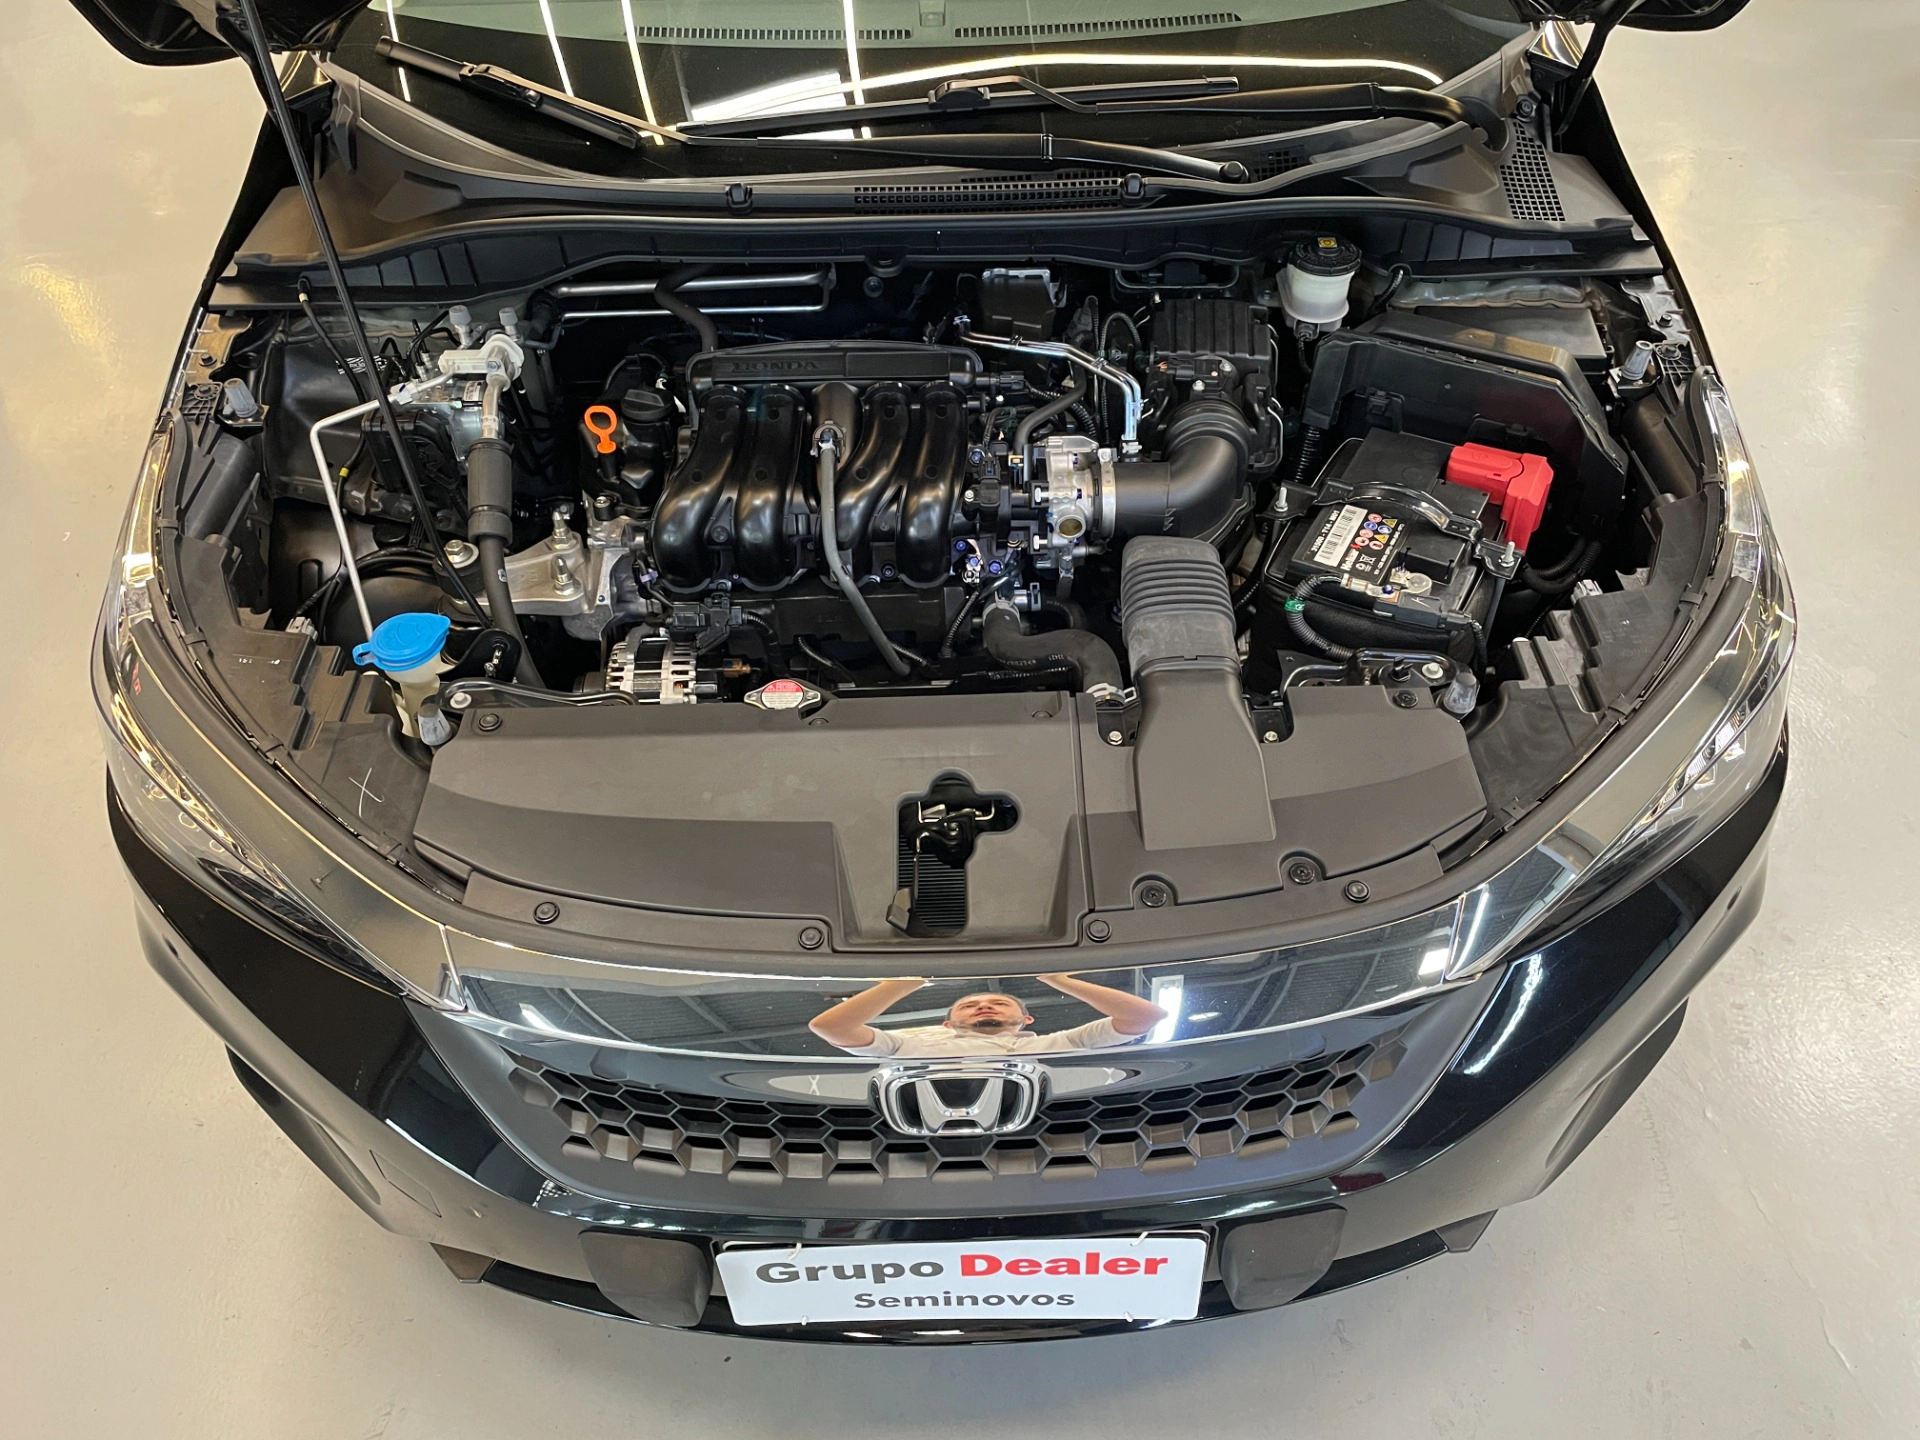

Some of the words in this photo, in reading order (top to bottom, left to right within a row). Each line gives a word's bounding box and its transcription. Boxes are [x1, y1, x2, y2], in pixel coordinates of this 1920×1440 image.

[731, 361, 818, 373] HONDA
[756, 1261, 944, 1284] Grupo
[960, 1252, 1169, 1277] Dealer
[854, 1291, 1075, 1308] Seminovos
